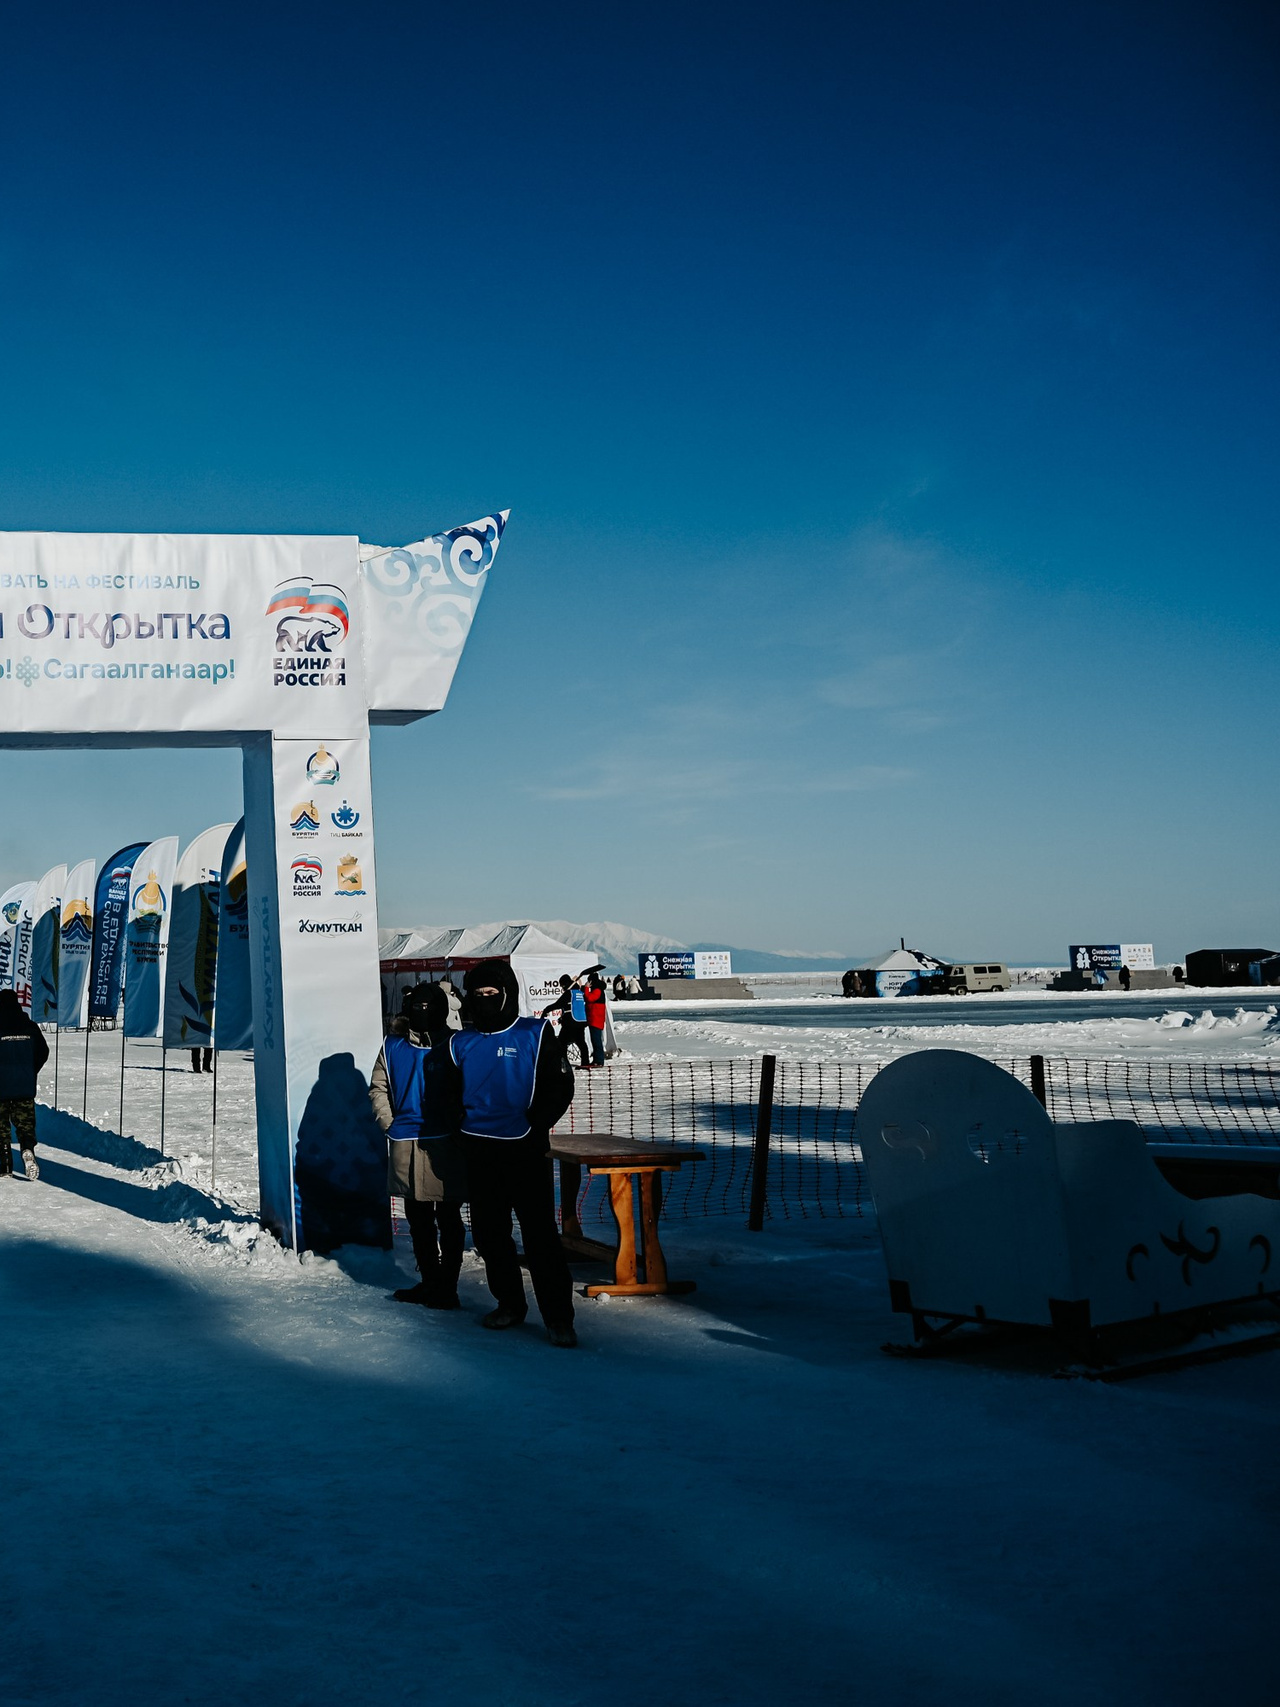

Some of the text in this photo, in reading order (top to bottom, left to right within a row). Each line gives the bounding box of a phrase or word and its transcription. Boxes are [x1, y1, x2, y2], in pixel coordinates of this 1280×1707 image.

[54, 574, 80, 590] НА
[85, 574, 200, 590] ФЕСТИВАЛЬ
[17, 603, 231, 649] Открытка
[43, 658, 235, 685] Сагаалганаар!
[273, 657, 346, 671] ЕДИНАЯ
[274, 672, 346, 686] РОССИЯ
